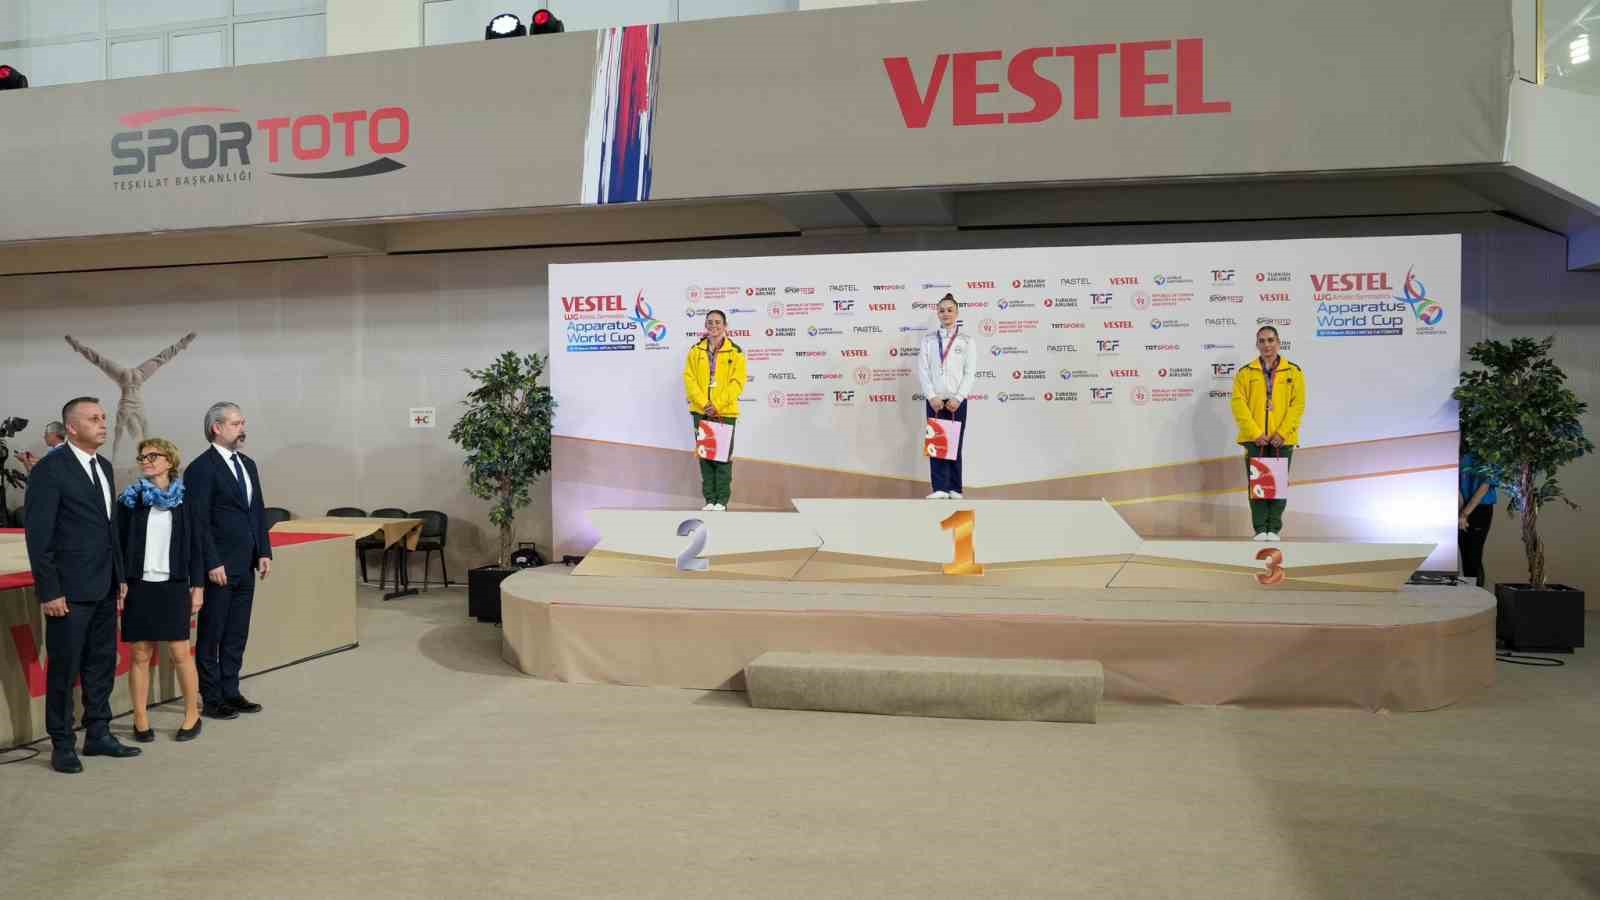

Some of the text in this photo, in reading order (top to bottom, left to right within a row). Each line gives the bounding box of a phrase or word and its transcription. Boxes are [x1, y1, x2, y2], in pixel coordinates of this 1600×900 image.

[883, 38, 1231, 128] VESTEL
[967, 281, 996, 289] VESTEL
[1110, 277, 1139, 285] VESTEL
[1310, 272, 1393, 292] VESTEL
[1259, 293, 1290, 301] VESTEL
[562, 295, 627, 313] VESTEL
[868, 303, 897, 312] VESTEL
[1317, 302, 1406, 314] Apparatus
[567, 320, 637, 332] Apparatus
[1103, 321, 1133, 329] VESTEL
[1317, 314, 1404, 328] World Cup
[567, 332, 635, 344] World Cup
[841, 349, 869, 357] VESTEL
[1110, 369, 1139, 377] VESTEL
[869, 394, 897, 402] VESTEL
[676, 518, 710, 571] 2
[940, 510, 983, 575] 1
[1255, 547, 1284, 585] 3
